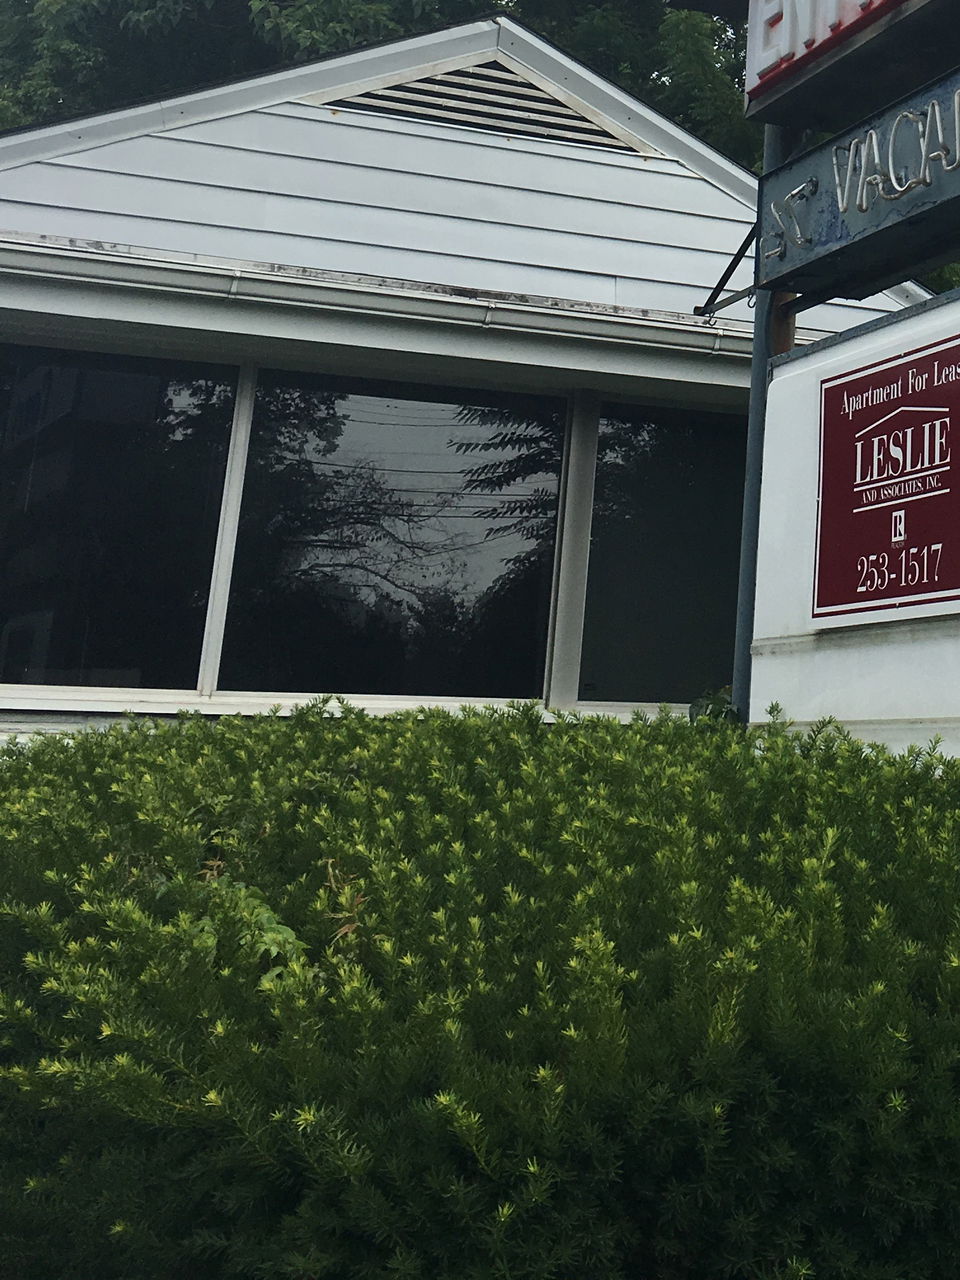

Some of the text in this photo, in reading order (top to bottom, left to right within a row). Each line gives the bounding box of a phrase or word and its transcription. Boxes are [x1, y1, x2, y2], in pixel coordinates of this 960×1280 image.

[840, 376, 902, 420] Apartment
[908, 368, 929, 394] For
[854, 417, 951, 485] LESLIE
[861, 489, 877, 505] AND
[926, 474, 942, 490] INC.
[856, 543, 943, 593] 253-1517
